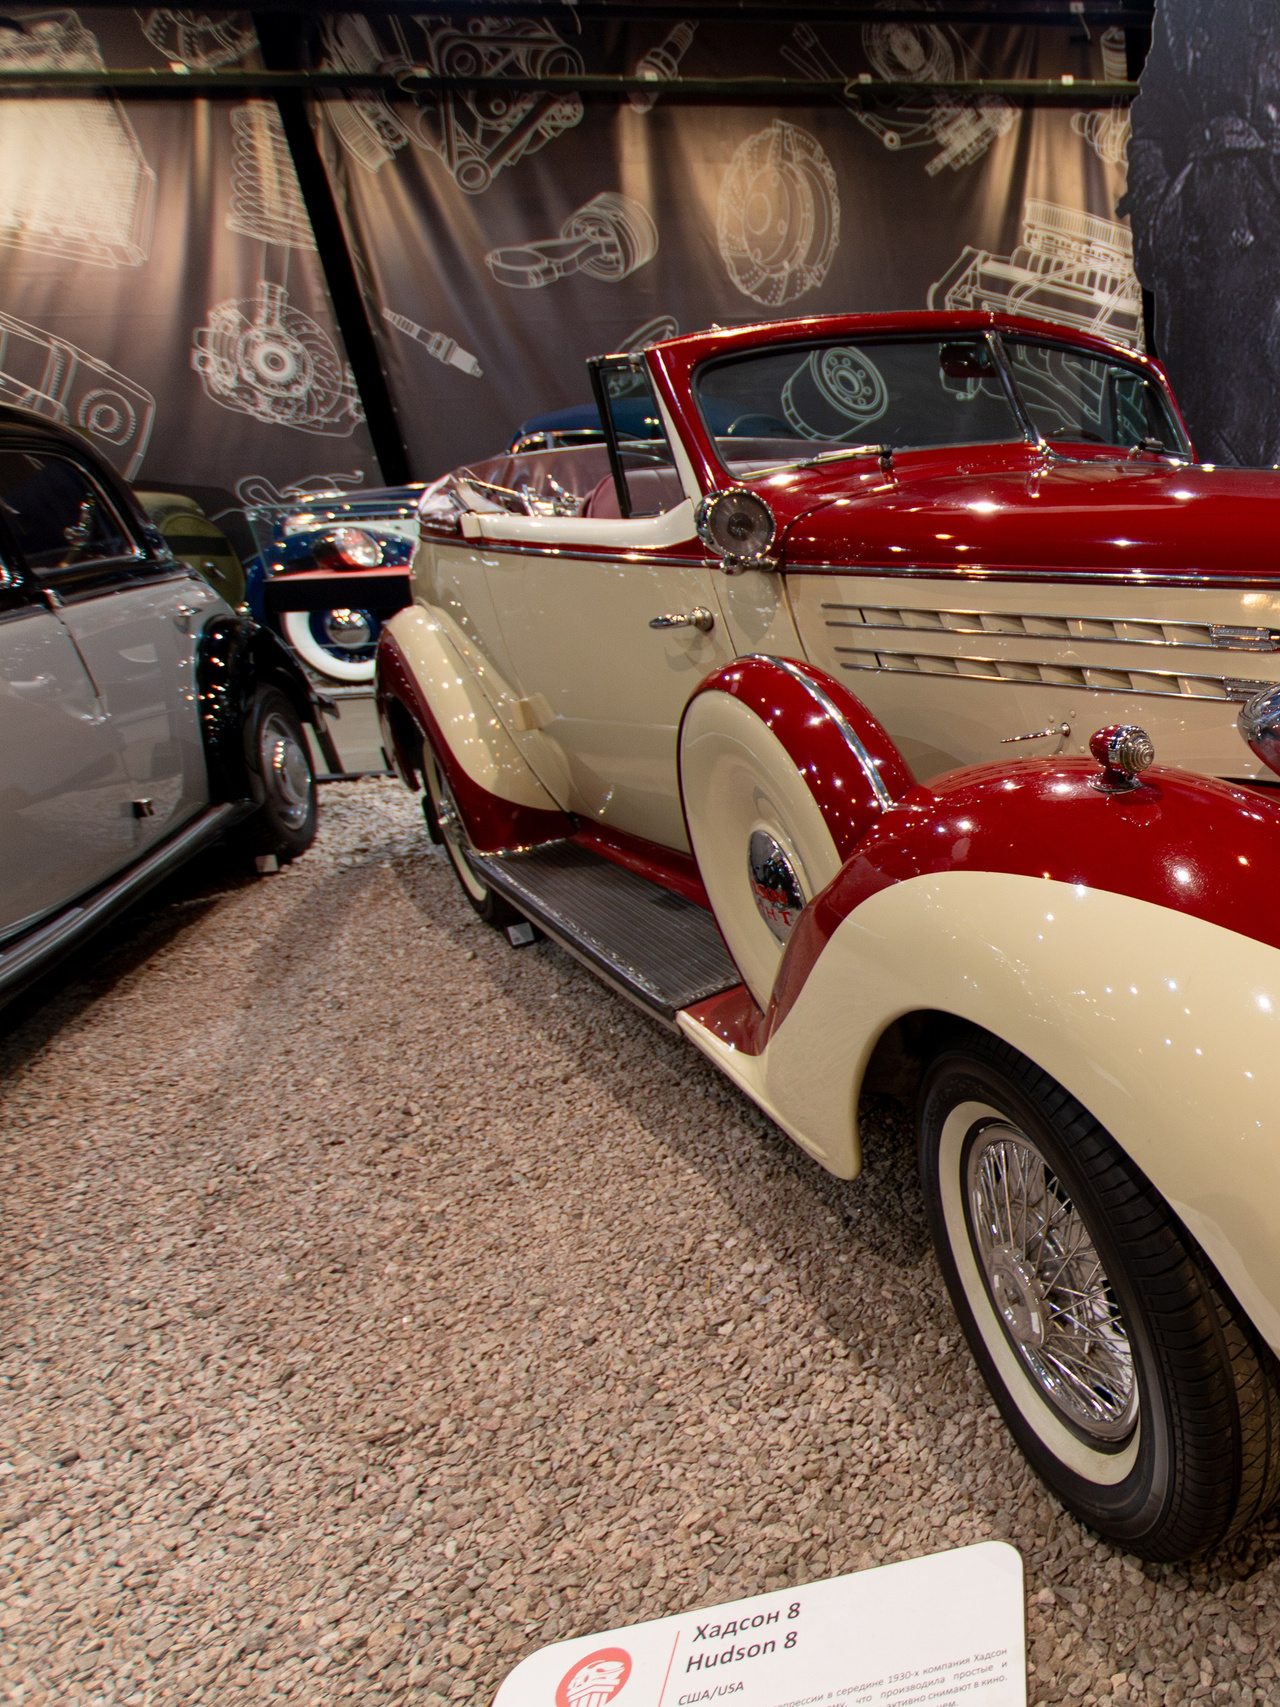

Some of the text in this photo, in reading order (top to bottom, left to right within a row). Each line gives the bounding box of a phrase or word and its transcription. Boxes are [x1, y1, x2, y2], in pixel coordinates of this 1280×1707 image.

[692, 1602, 801, 1643] Хадсон 8
[685, 1631, 798, 1674] Hudson 8
[678, 1681, 745, 1706] США/USA
[827, 1691, 834, 1699] в
[836, 1679, 884, 1697] середине
[888, 1670, 920, 1684] 1930-х
[922, 1657, 971, 1675] компания
[973, 1648, 1008, 1662] Хадсон
[855, 1695, 873, 1705] что
[880, 1676, 946, 1699] производила
[953, 1664, 994, 1682] простые
[927, 1682, 972, 1700] снимают
[981, 1674, 1008, 1687] кино.
